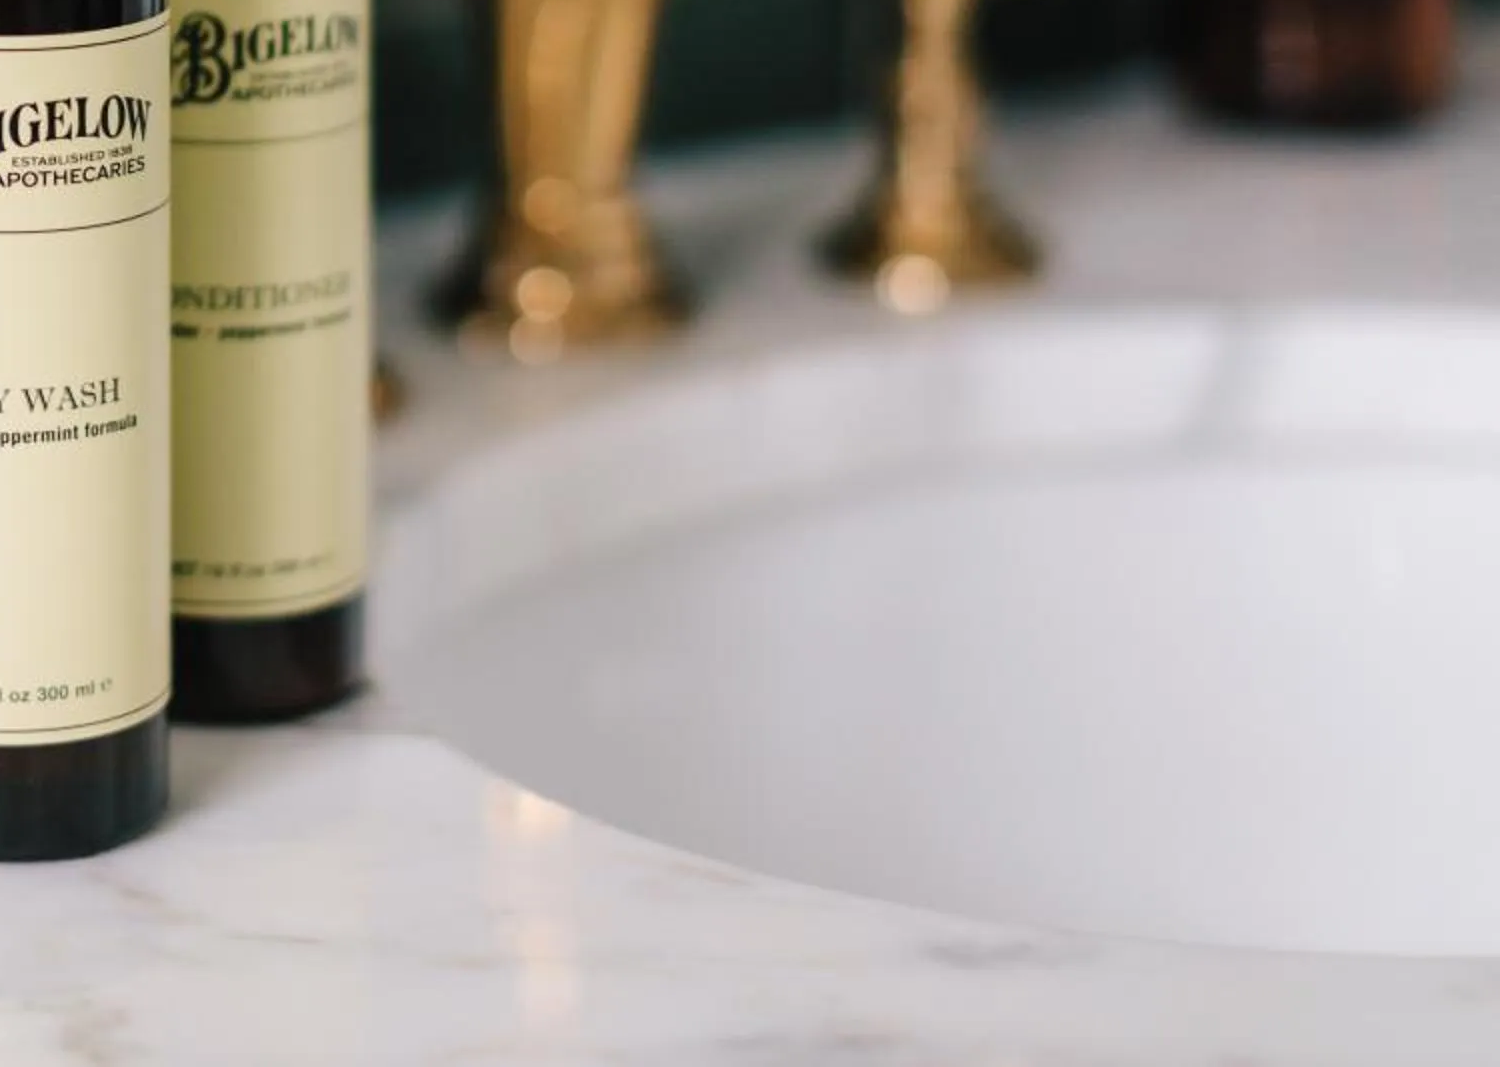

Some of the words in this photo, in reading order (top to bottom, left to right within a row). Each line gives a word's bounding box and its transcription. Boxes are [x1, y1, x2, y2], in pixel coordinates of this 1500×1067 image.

[11, 150, 105, 168] ESTABLISHED
[21, 378, 121, 412] WASH
[84, 414, 137, 438] formula
[9, 690, 30, 702] oz
[36, 684, 69, 701] 300
[75, 679, 95, 698] ml
